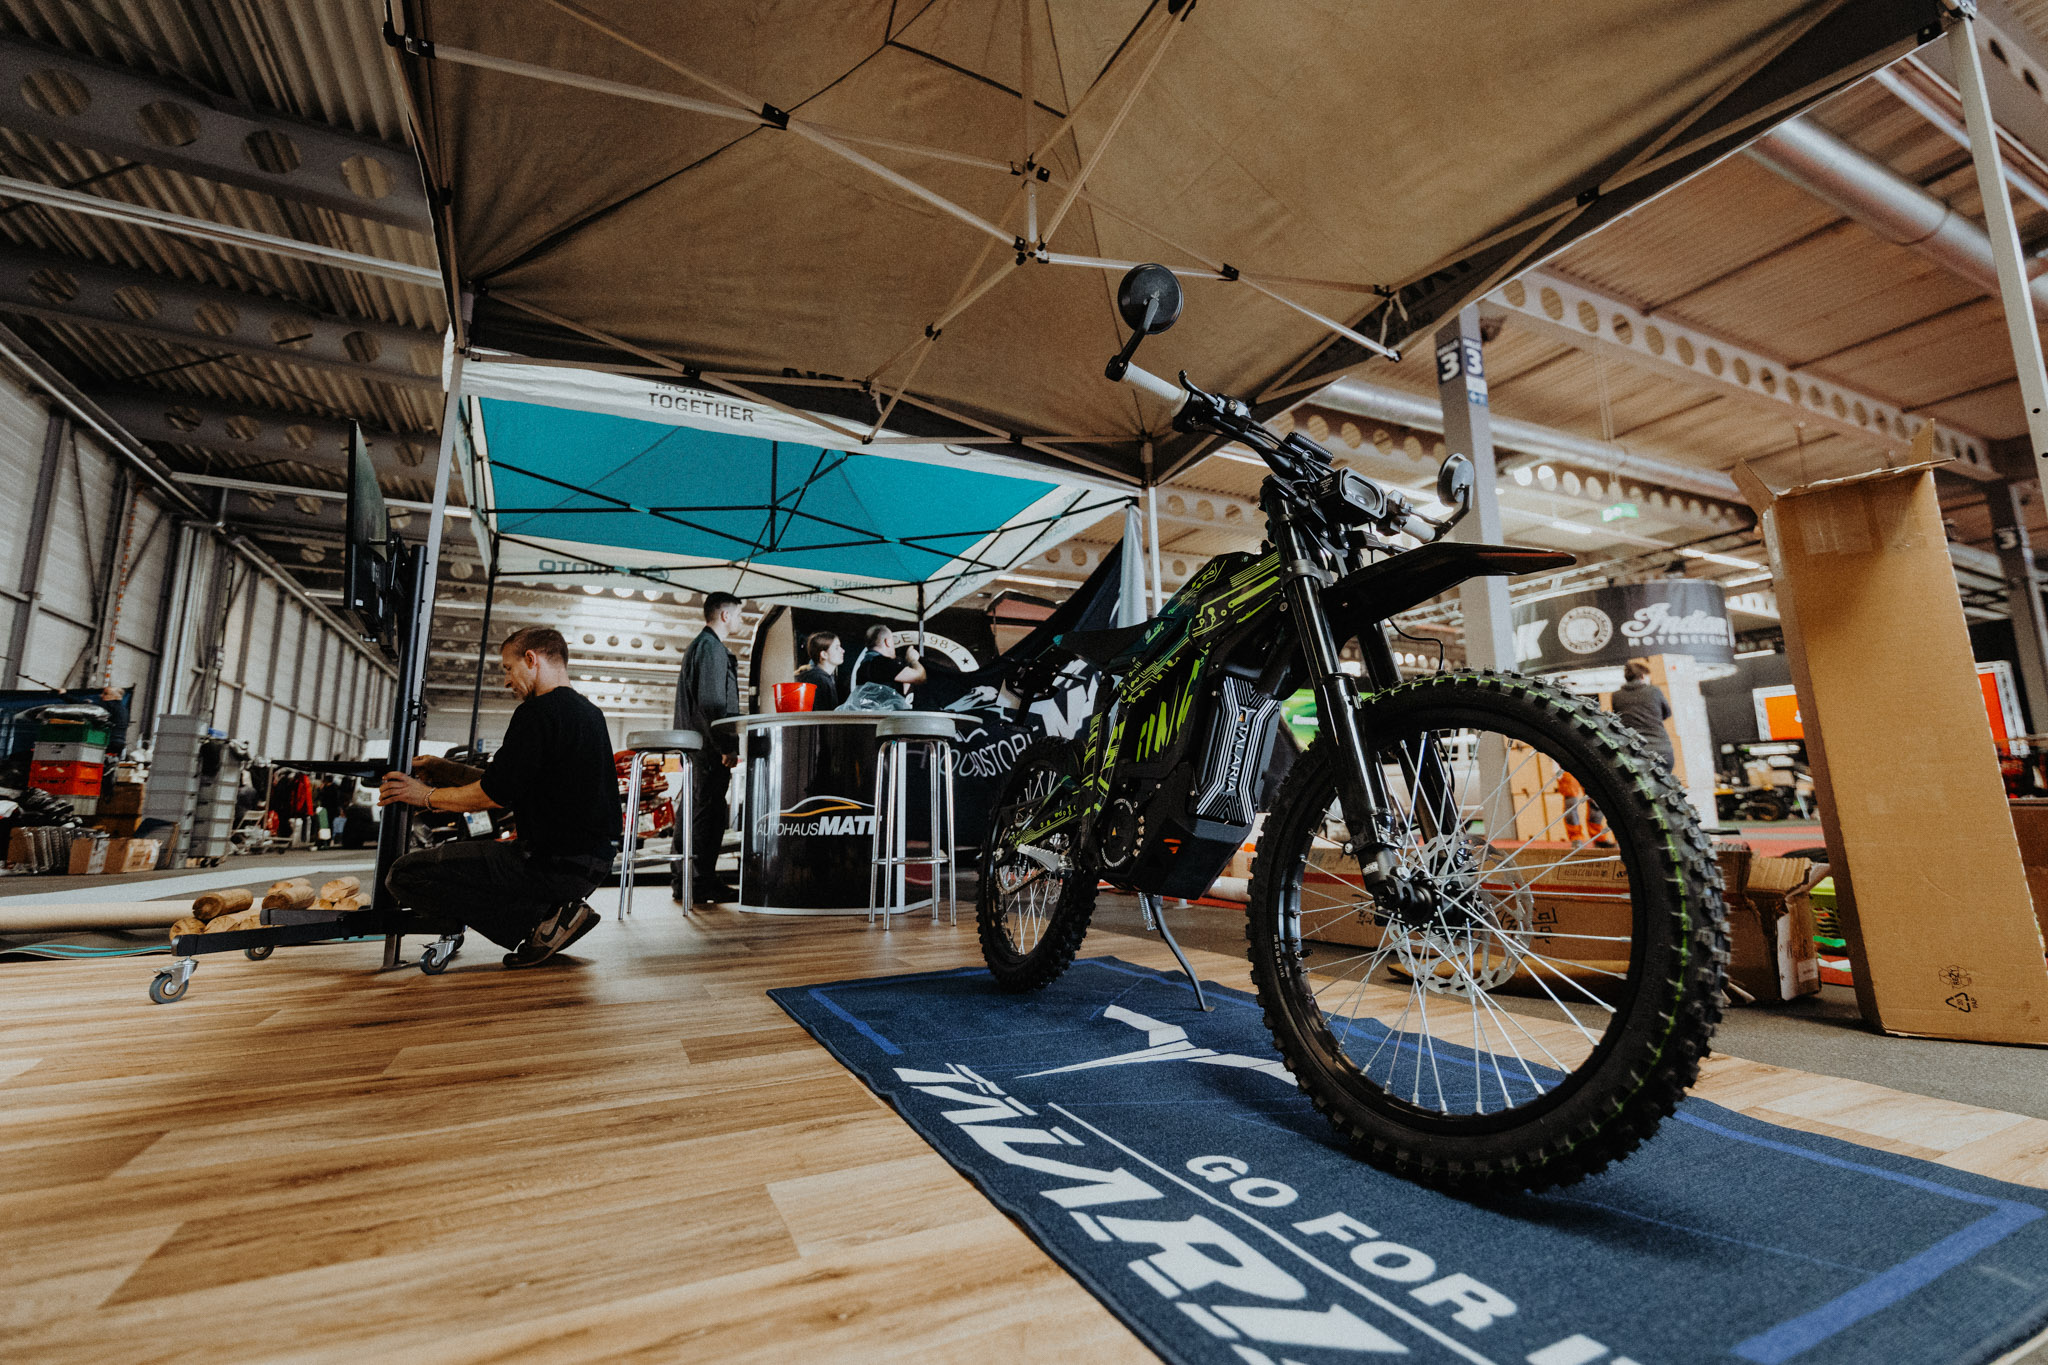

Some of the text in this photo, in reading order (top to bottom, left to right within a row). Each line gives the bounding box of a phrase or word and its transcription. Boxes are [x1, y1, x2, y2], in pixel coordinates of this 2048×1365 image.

[1440, 351, 1460, 382] 3
[1464, 347, 1483, 375] 3
[648, 392, 755, 423] TOGETHER
[1225, 724, 1250, 793] TALARIA
[892, 1062, 1409, 1365] TALARI
[1186, 1154, 1518, 1332] GO FOR
